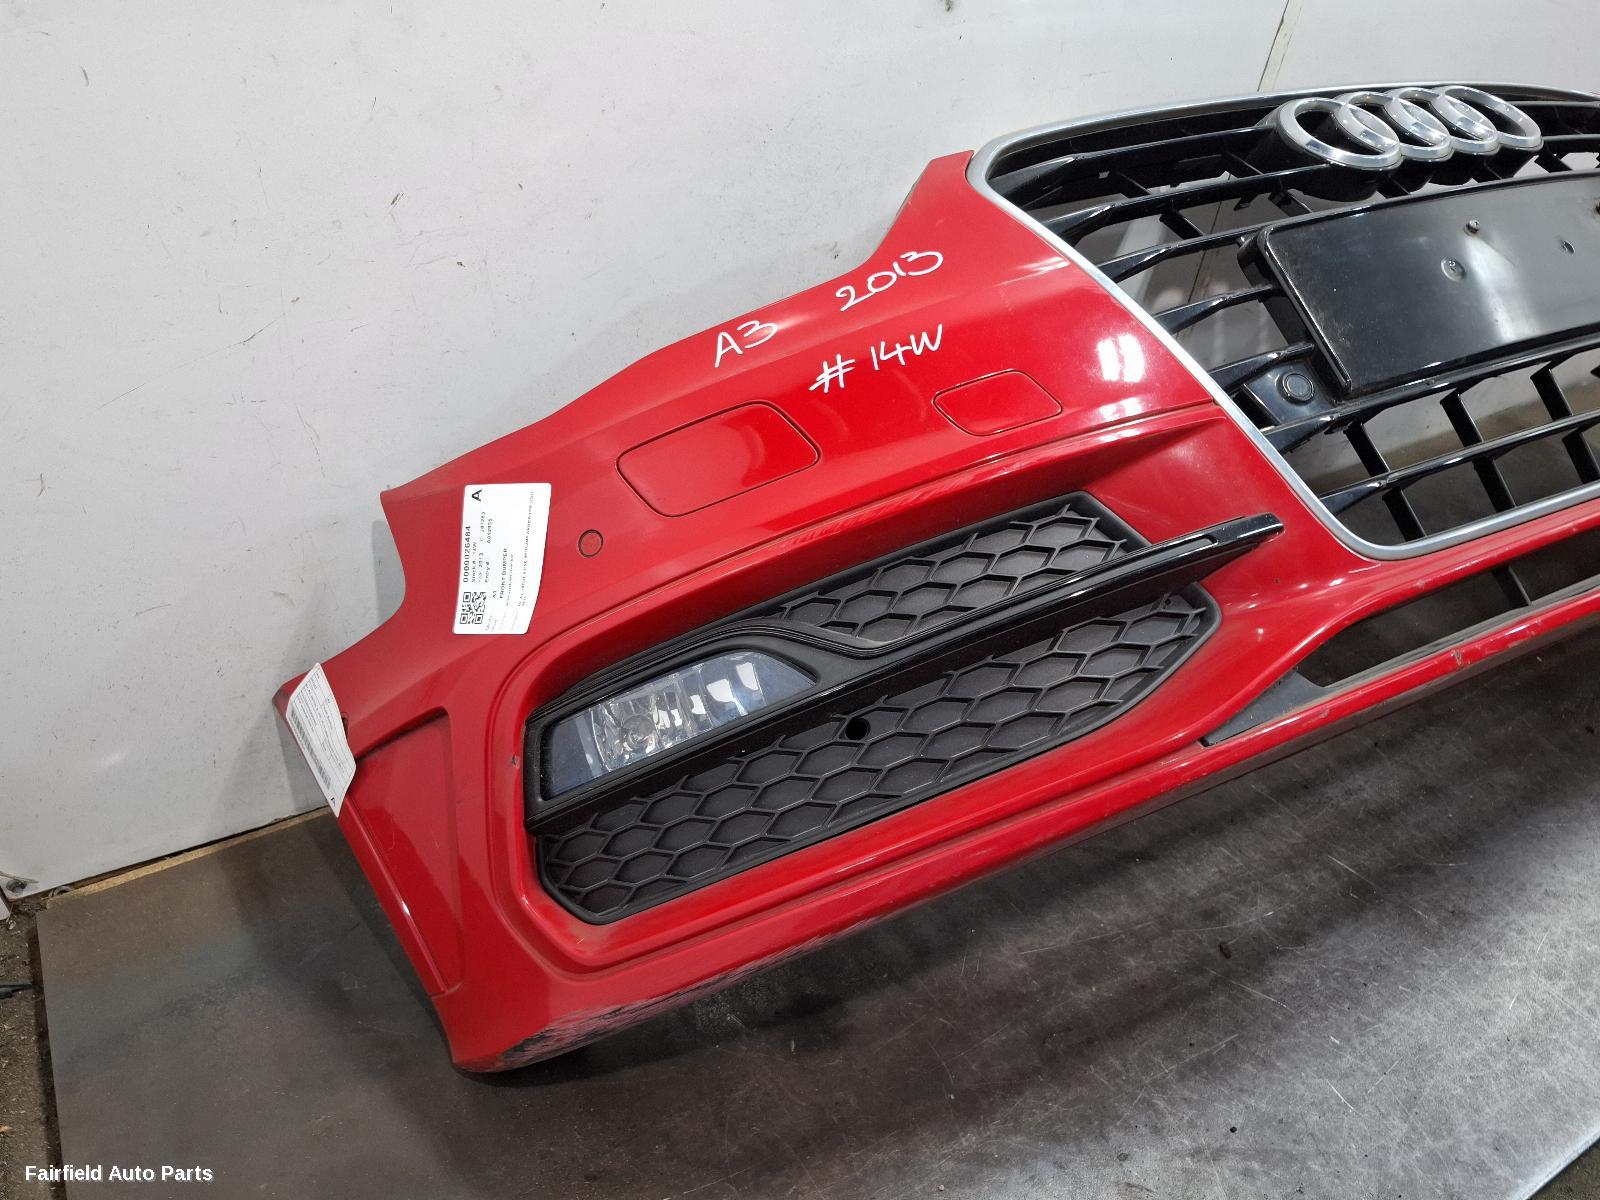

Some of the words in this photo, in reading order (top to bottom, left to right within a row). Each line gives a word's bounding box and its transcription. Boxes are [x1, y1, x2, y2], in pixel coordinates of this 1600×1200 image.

[714, 320, 778, 368] A3
[835, 251, 943, 311] 2013
[809, 354, 855, 393] #
[870, 324, 943, 371] 14W
[471, 489, 482, 502] A
[463, 526, 471, 583] 0000026484
